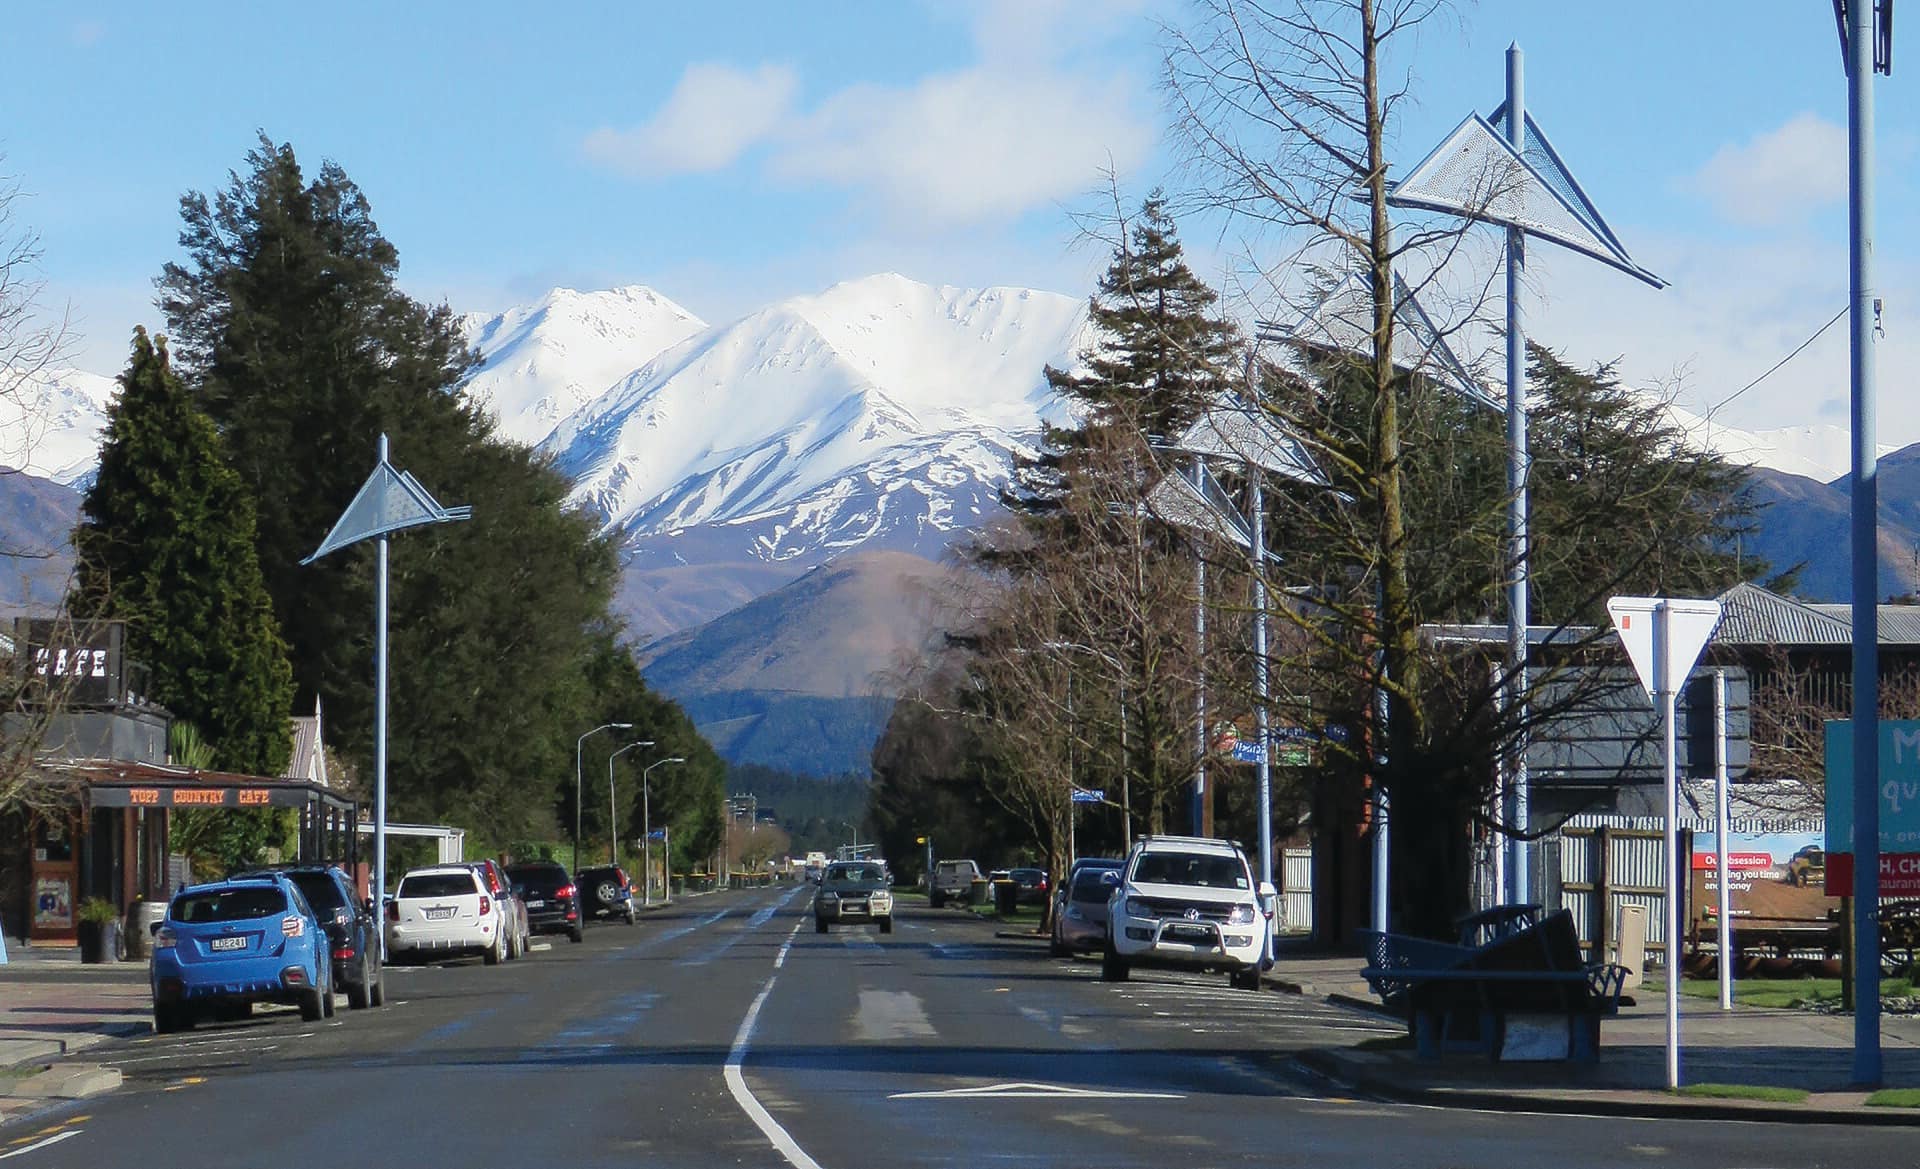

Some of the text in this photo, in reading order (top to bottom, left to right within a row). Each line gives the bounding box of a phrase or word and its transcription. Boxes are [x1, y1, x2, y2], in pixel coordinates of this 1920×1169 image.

[36, 648, 106, 677] CAFE
[130, 789, 270, 804] TOPP COUNTRY CAFE
[1728, 855, 1767, 865] bsession
[1704, 870, 1713, 879] is
[1742, 871, 1758, 881] you
[1760, 870, 1780, 879] time
[1728, 882, 1752, 892] oney
